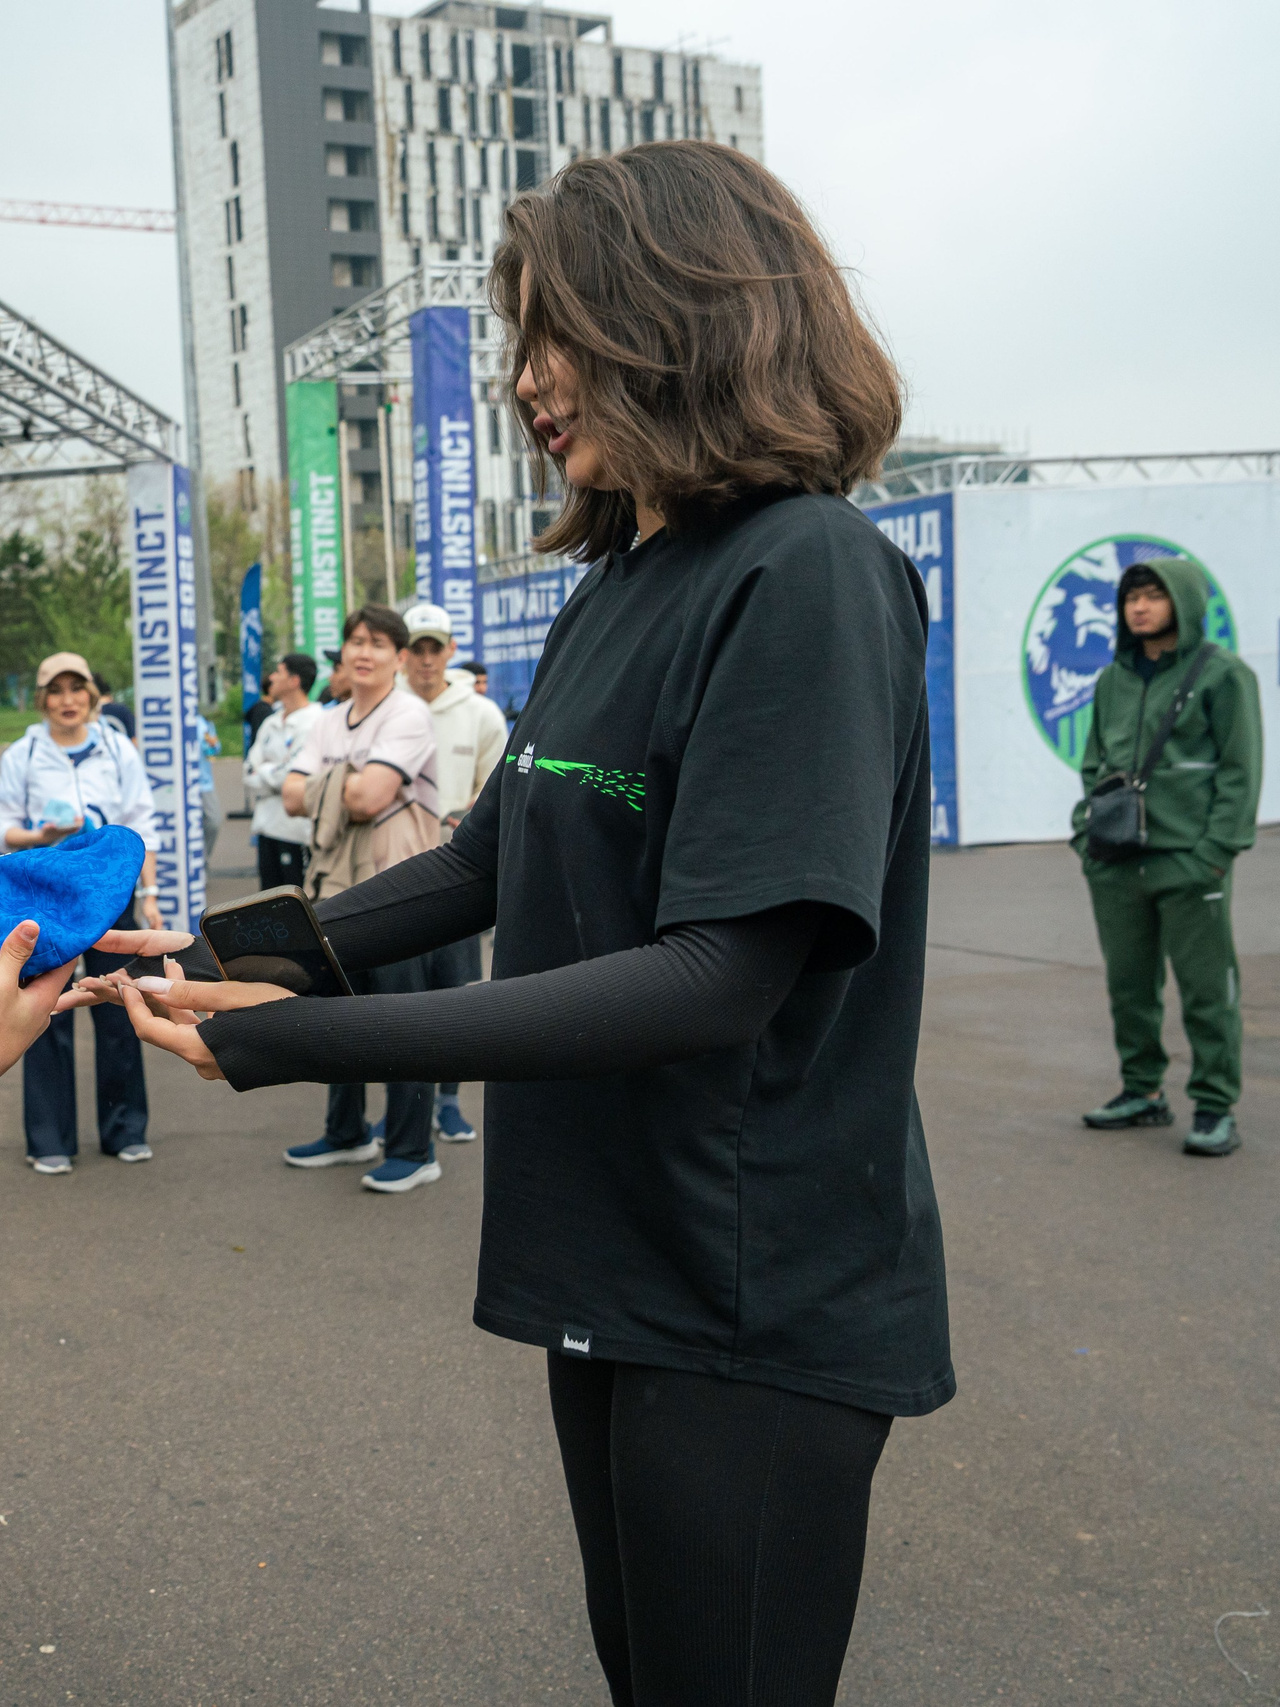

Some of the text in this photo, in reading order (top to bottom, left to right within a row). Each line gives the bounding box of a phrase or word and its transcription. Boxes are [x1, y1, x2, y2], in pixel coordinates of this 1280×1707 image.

[310, 471, 337, 599] INSTINCT
[440, 414, 472, 569] INSTINCT
[181, 642, 199, 728] MAN
